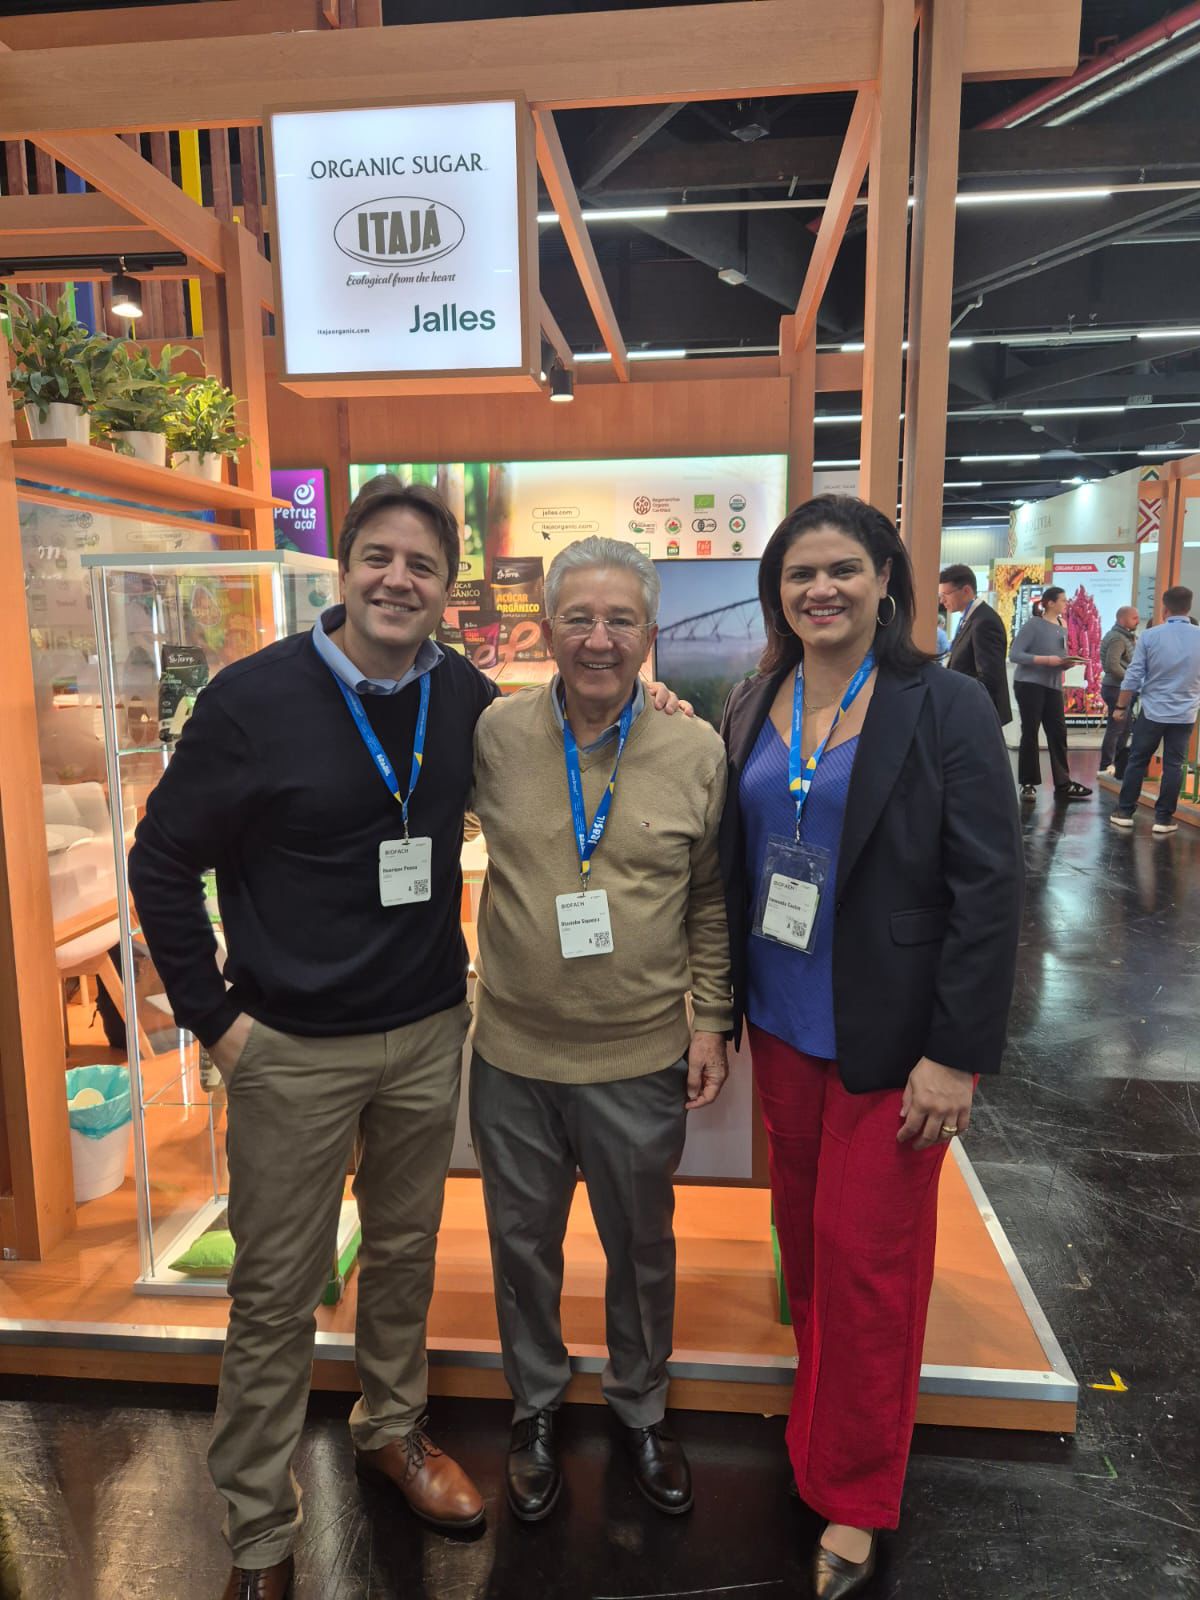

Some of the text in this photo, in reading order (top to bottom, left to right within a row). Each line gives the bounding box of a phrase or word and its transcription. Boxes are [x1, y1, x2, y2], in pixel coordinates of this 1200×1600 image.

[310, 152, 483, 179] ORGANIC SUGAR
[358, 203, 441, 255] ITAJÁ
[346, 271, 456, 288] Ecological from the heart
[409, 302, 496, 333] Jalles
